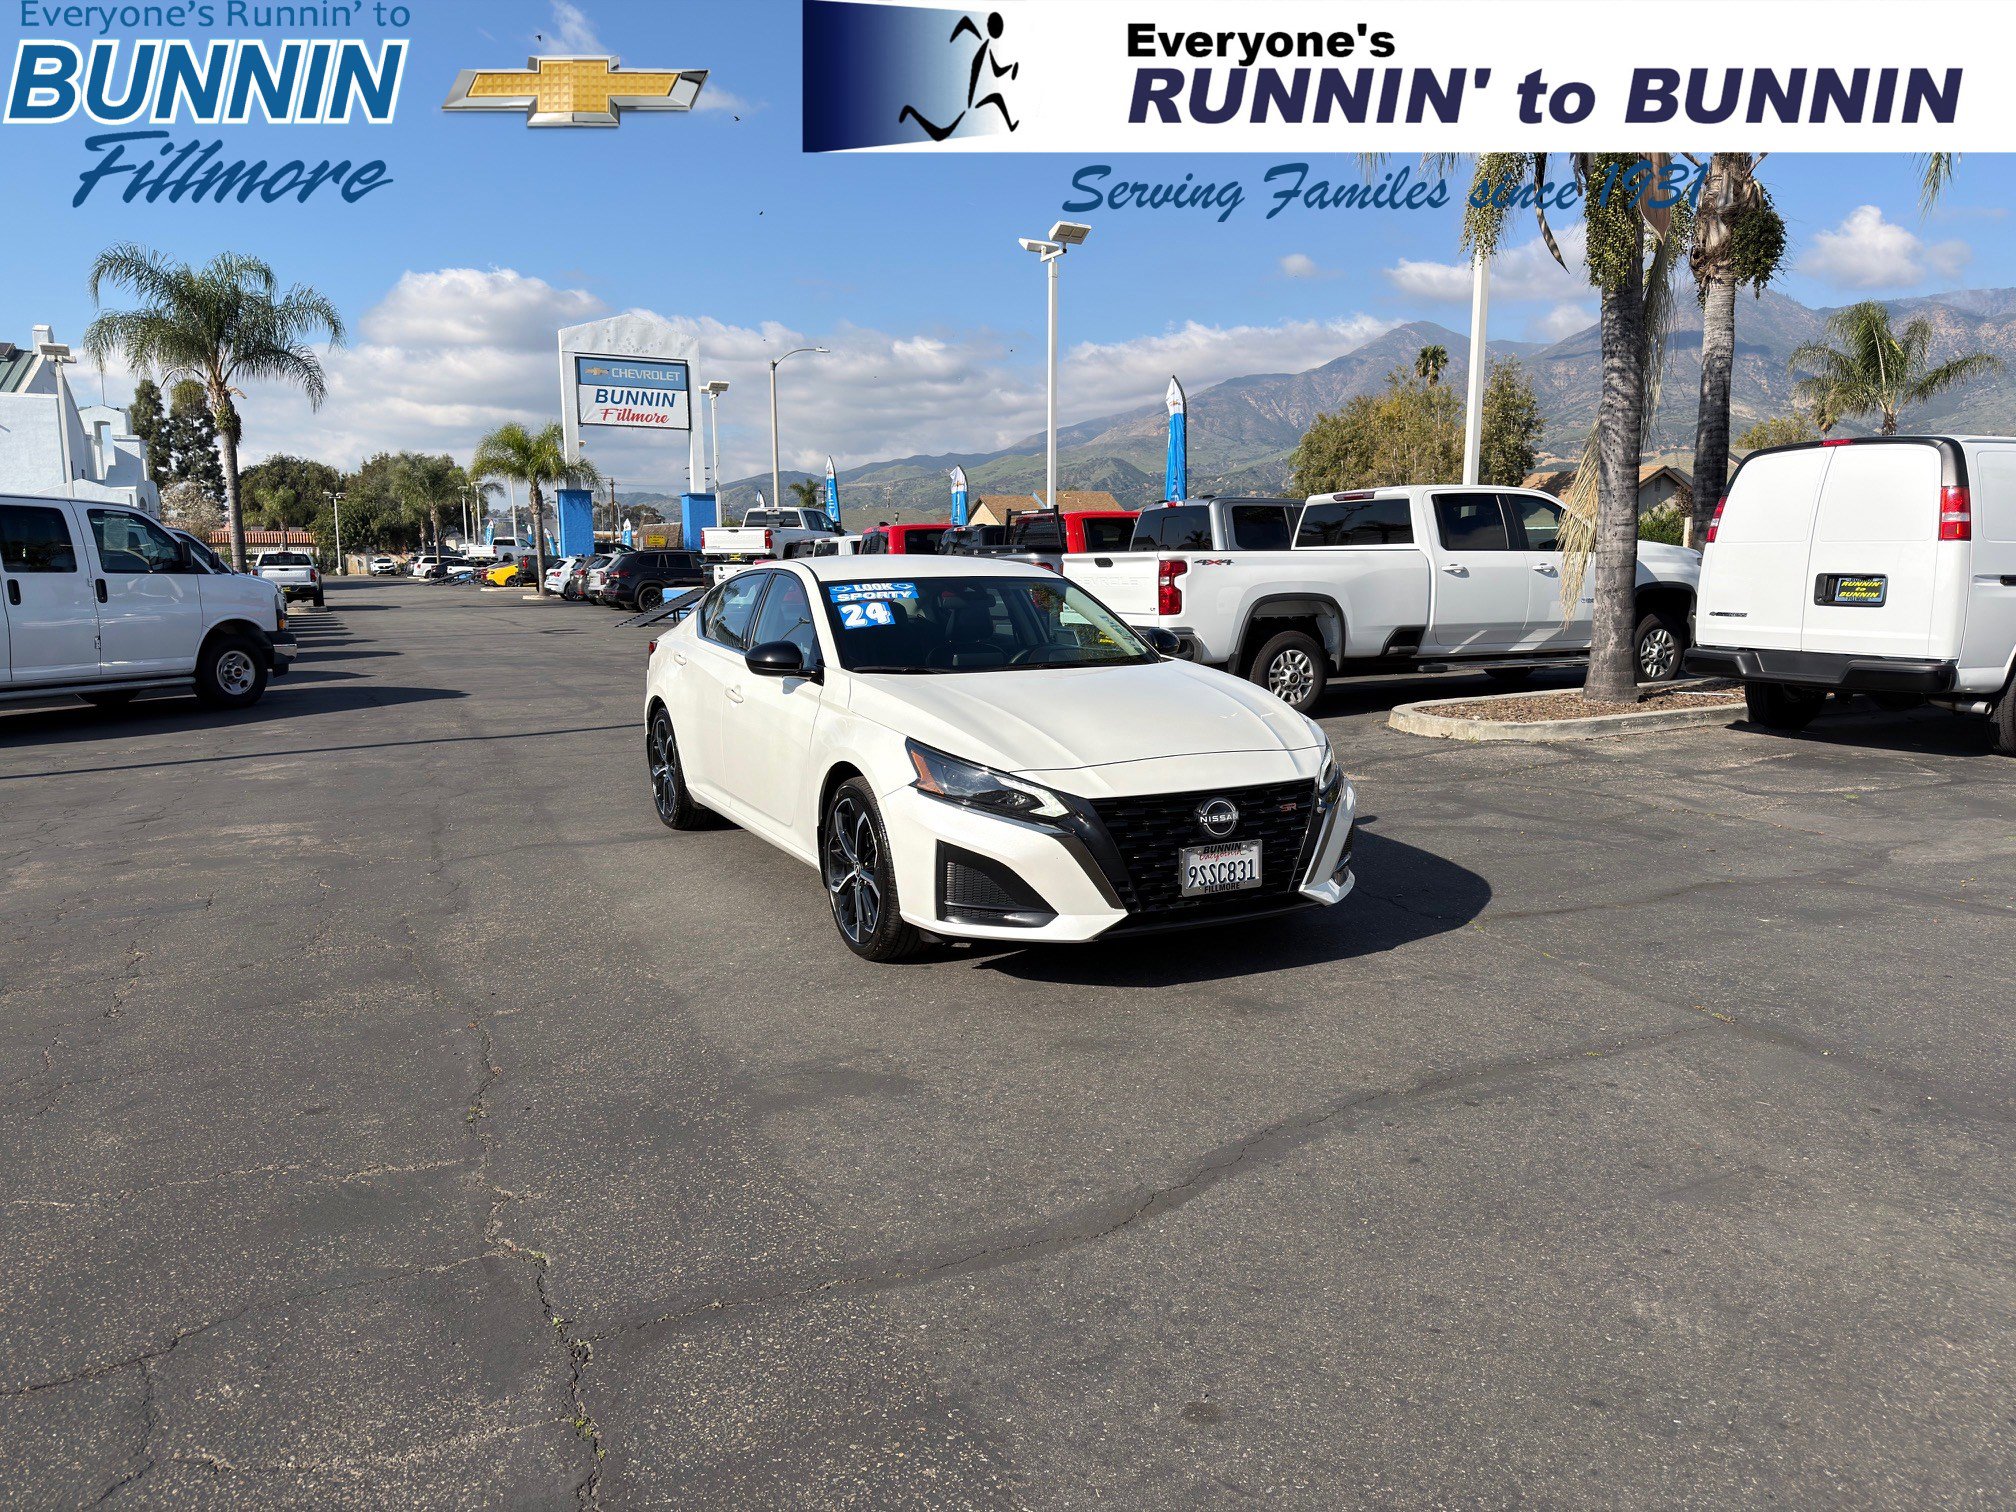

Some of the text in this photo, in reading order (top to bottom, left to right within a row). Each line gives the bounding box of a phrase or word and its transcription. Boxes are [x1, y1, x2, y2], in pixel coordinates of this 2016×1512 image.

[611, 367, 681, 382] CHEVROLET
[594, 388, 676, 408] BUNNIN
[600, 407, 670, 424] Fillmore
[853, 583, 893, 591] LOOK
[837, 591, 912, 601] SPORTY
[841, 602, 890, 627] 24
[1200, 813, 1238, 823] NISSAN
[1203, 842, 1242, 854] BUNNIN
[1188, 858, 1256, 888] 9SSC831
[1204, 882, 1240, 893] FILLMORE
